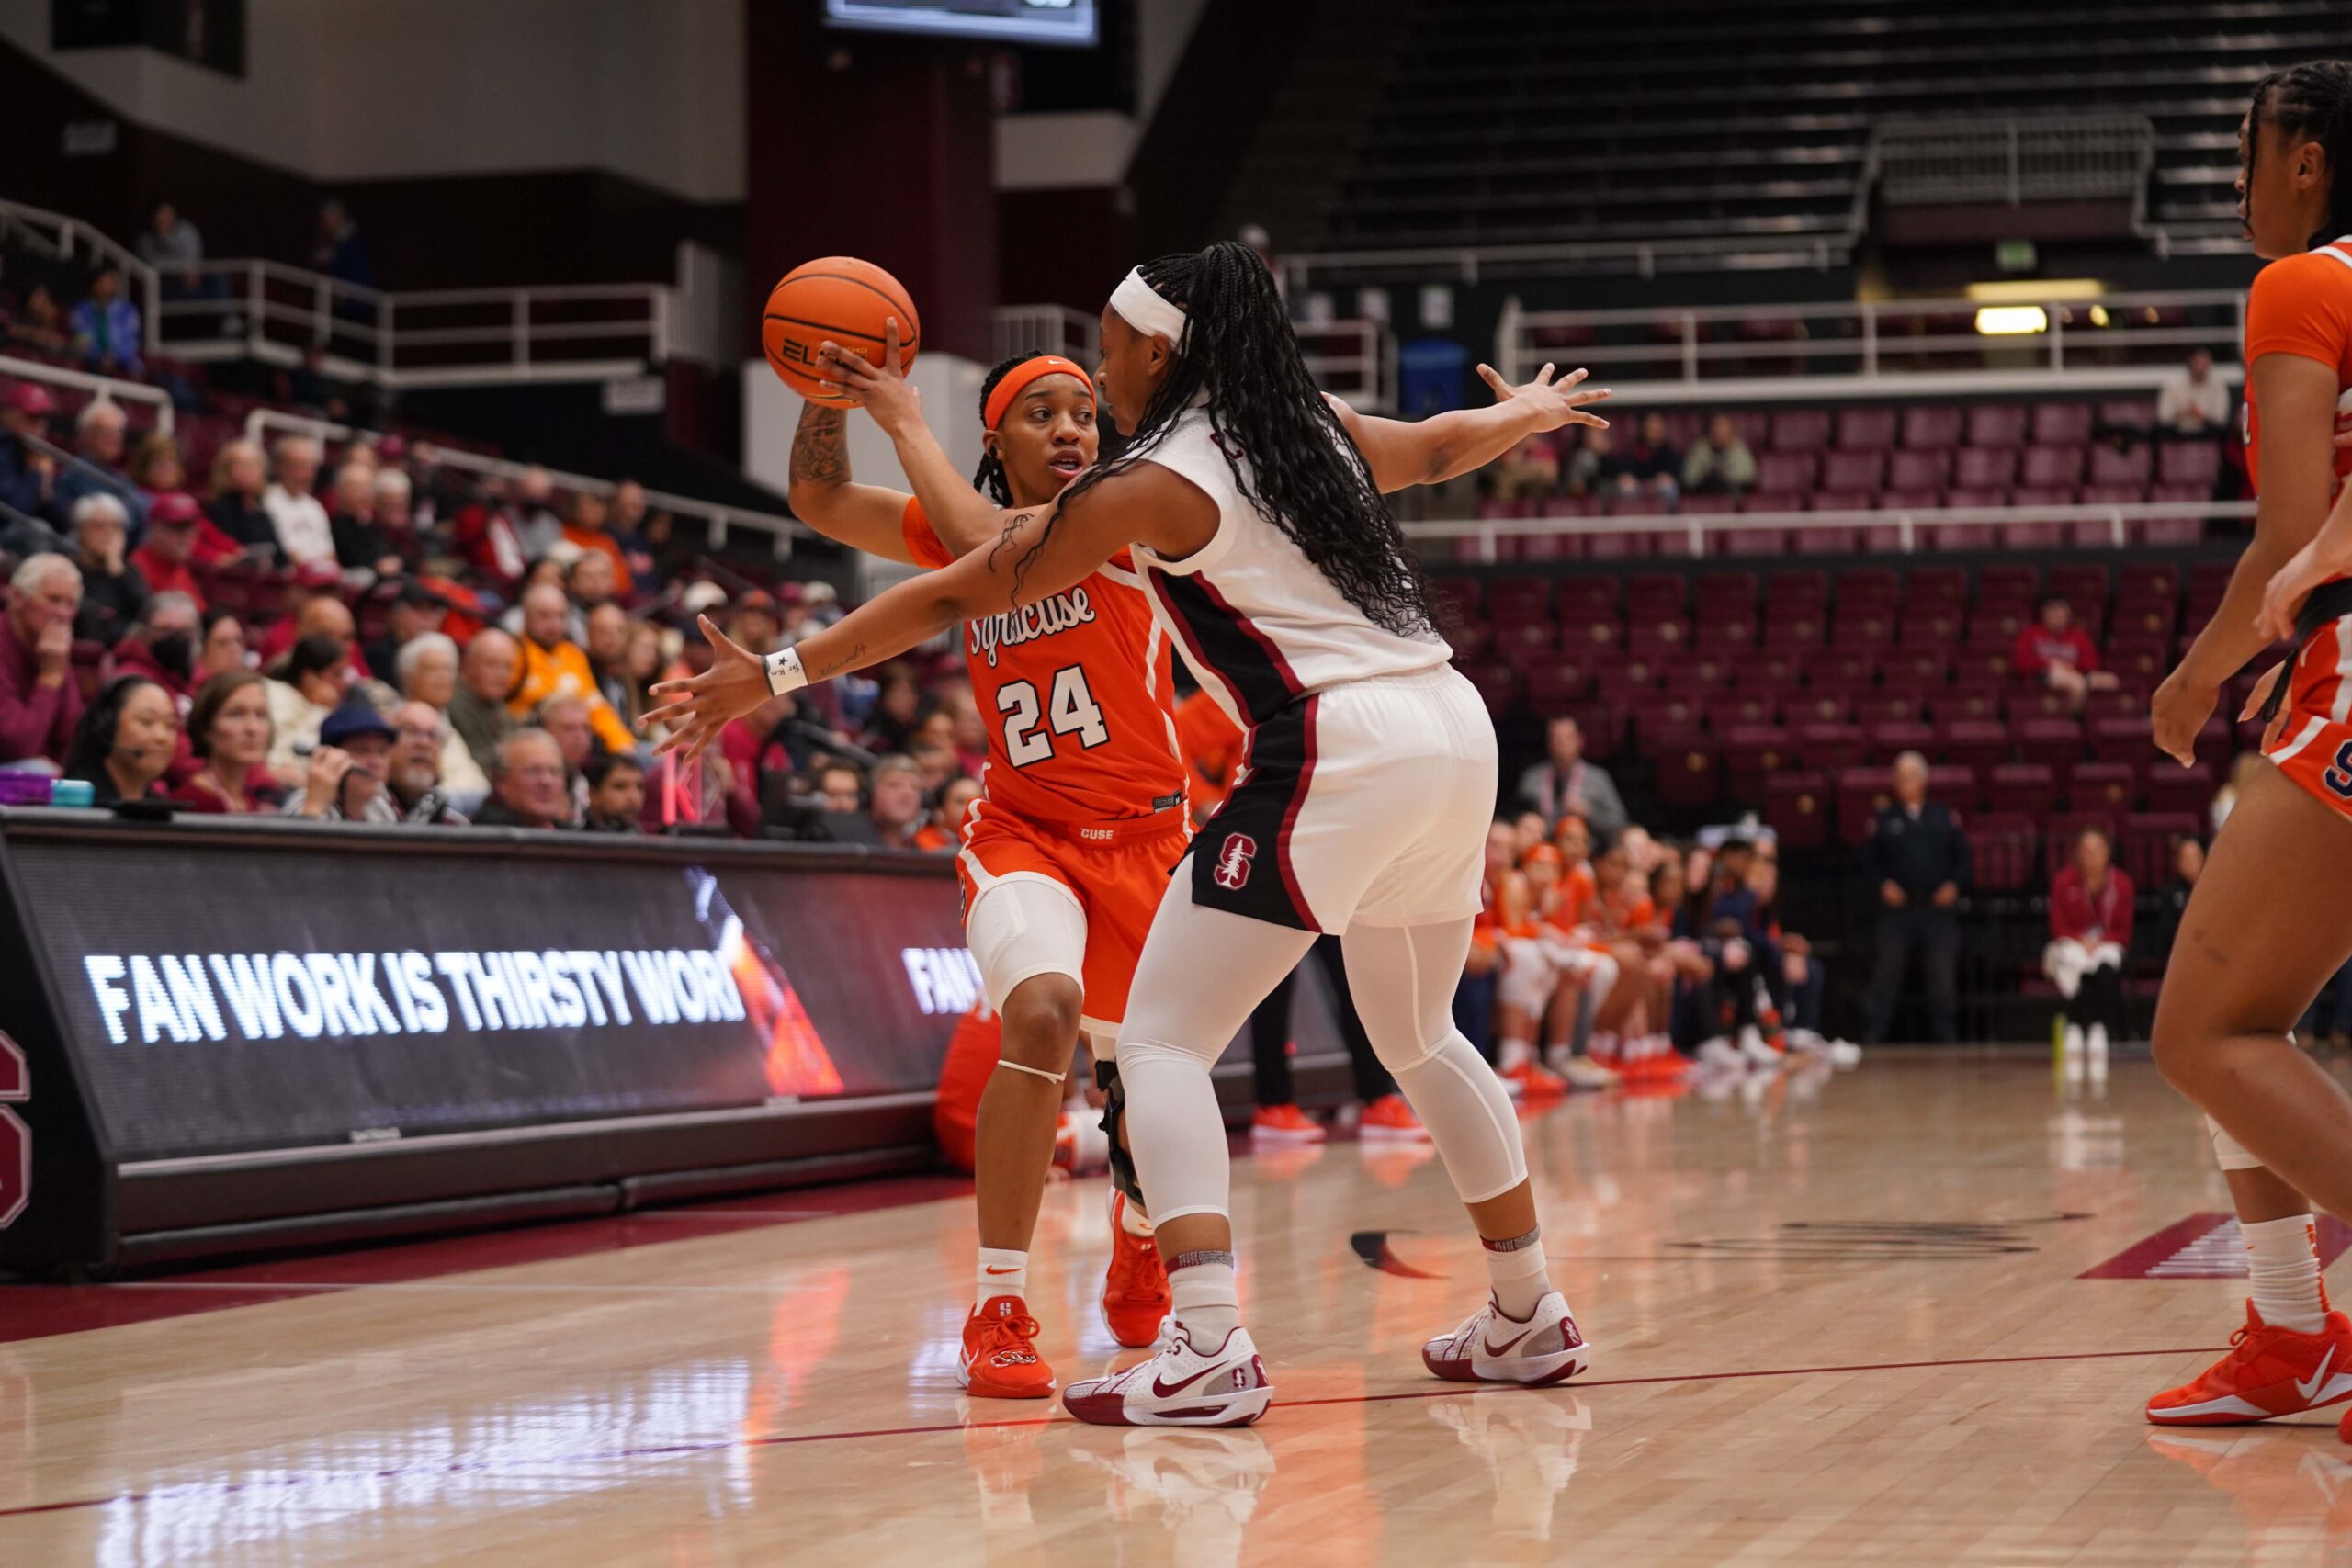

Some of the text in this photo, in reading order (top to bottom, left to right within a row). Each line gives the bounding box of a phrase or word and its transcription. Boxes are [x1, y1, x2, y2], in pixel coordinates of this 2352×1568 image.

[995, 662, 1111, 769] 24
[84, 954, 228, 1045] FAN
[209, 952, 401, 1040] WORK
[380, 950, 449, 1033] IS
[434, 950, 633, 1032] THIRSTY
